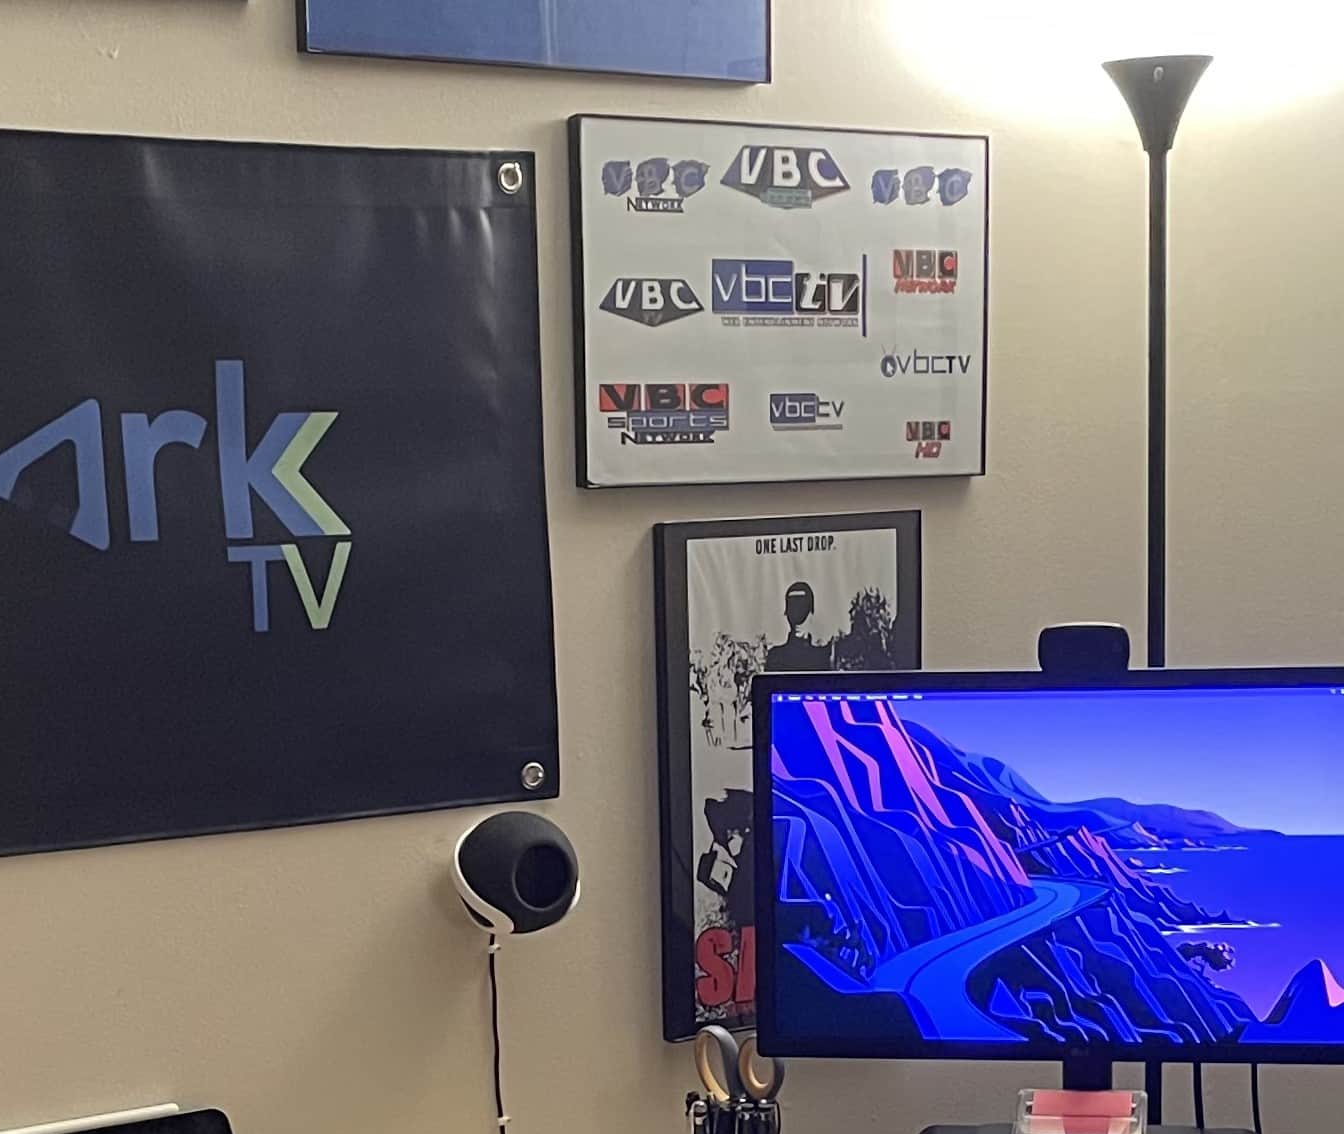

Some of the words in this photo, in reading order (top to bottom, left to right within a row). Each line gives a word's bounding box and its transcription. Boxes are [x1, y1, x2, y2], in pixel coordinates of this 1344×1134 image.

[605, 160, 706, 196] VBC
[740, 146, 845, 188] VBC
[874, 167, 969, 204] VBC
[614, 278, 700, 311] VBC
[599, 384, 728, 411] VBC
[608, 411, 728, 432] sports
[755, 538, 777, 555] ONE
[779, 536, 804, 553] LAST
[226, 541, 353, 632] TV
